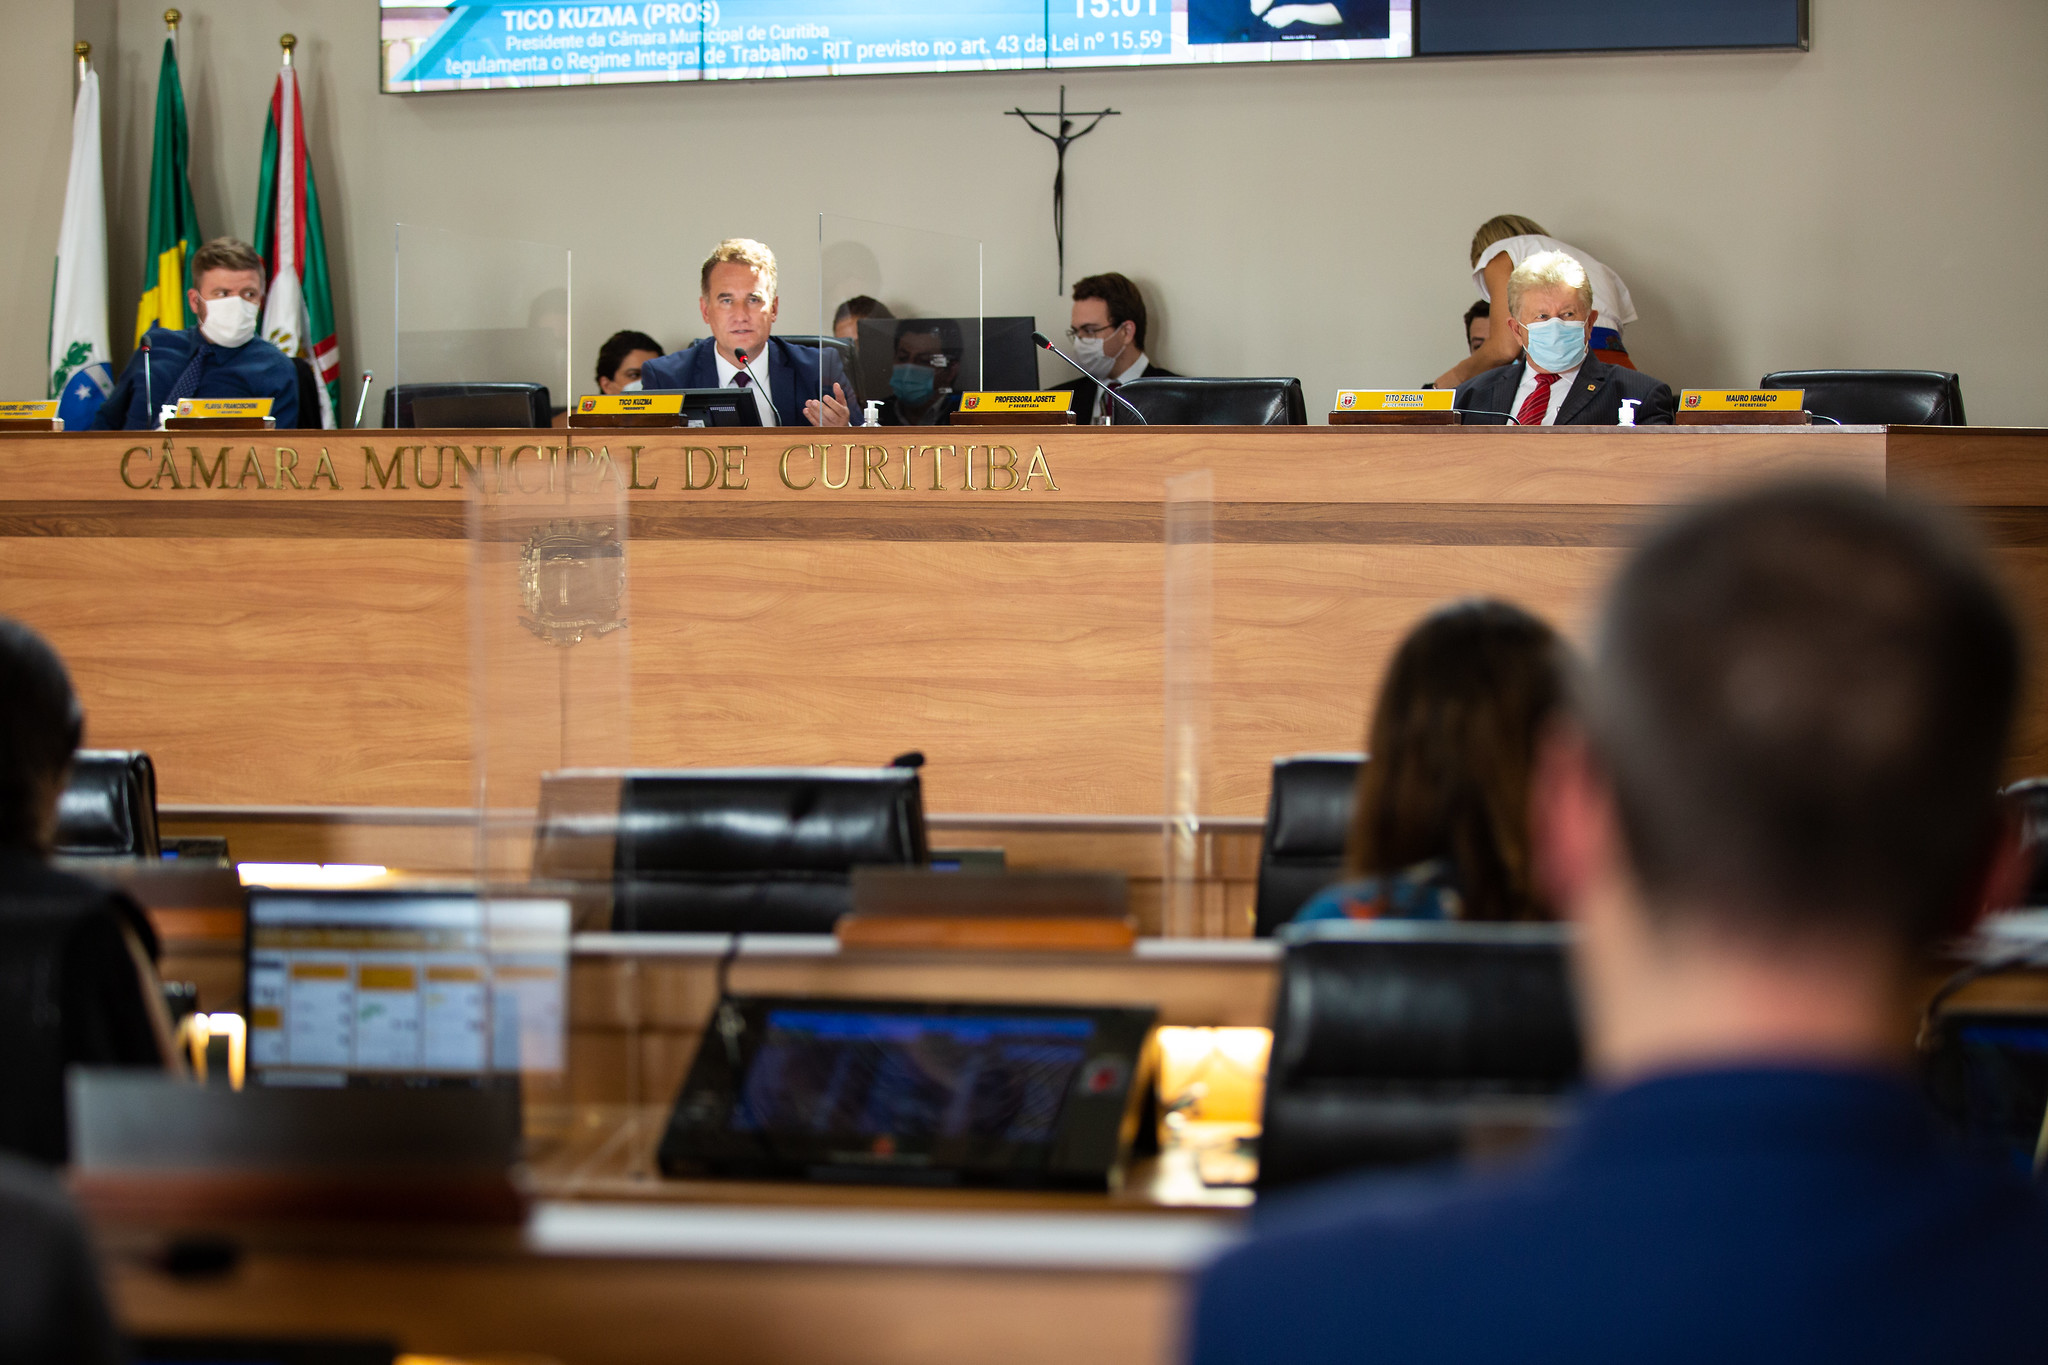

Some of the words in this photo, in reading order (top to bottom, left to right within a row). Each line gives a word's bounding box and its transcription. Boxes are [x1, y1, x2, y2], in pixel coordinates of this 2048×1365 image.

[501, 9, 553, 31] TICO
[557, 6, 638, 29] KUZMA
[642, 1, 719, 29] (PROS)
[505, 33, 584, 51] Presidente
[586, 32, 605, 48] da
[608, 31, 666, 47] Câmara
[669, 27, 743, 46] Municipal
[746, 25, 766, 41] de
[769, 23, 830, 40] Curitiba
[551, 56, 563, 71] o
[567, 51, 631, 74] Regime
[635, 46, 700, 70] Integral
[703, 46, 726, 65] de
[730, 43, 809, 64] Trabalho
[822, 40, 852, 60] RIT
[856, 39, 929, 63] previsto
[933, 41, 957, 56] no
[961, 37, 991, 55] art.
[996, 35, 1019, 54] 43
[1024, 33, 1047, 52] da
[1052, 32, 1079, 52] Lei
[1110, 29, 1163, 50] 15.59
[995, 395, 1032, 403] PROFESSORA
[1033, 395, 1056, 403] JOSETE
[1385, 394, 1399, 402] TITO
[1400, 394, 1424, 402] ZEGLIN
[1726, 394, 1749, 402] MAURO
[1750, 392, 1777, 402] IGNÁCIO
[119, 437, 343, 491] CÂMARA
[361, 444, 658, 493] MUNICIPAL
[681, 444, 750, 490] DE
[778, 443, 1060, 492] CURITIBA
